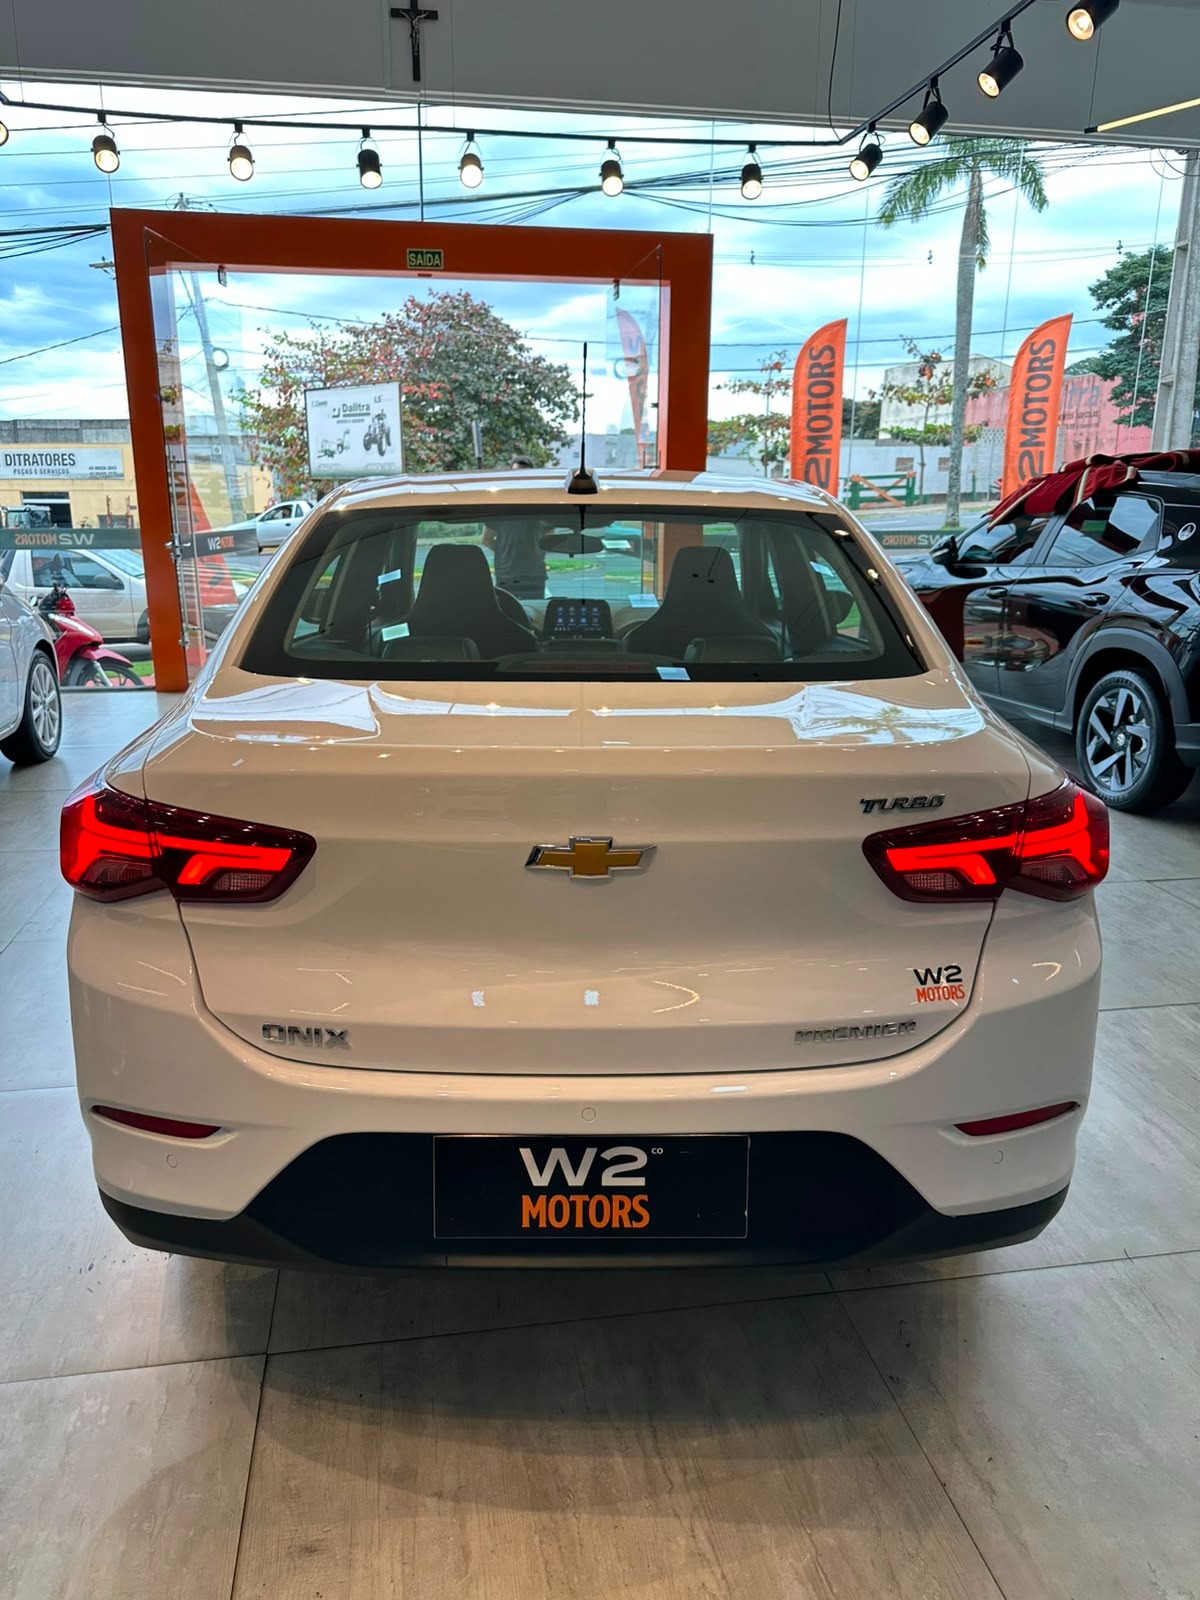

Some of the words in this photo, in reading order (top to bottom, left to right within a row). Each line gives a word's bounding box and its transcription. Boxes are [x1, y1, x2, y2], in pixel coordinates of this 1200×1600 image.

[409, 250, 441, 266] SAÍDA
[4, 453, 76, 467] DITRATORES
[13, 468, 33, 476] PEÇAS
[39, 468, 70, 476] SERVIÇOS
[860, 793, 946, 813] TURBO
[913, 965, 963, 986] W2
[915, 984, 966, 1004] MOTORS
[262, 1023, 351, 1048] ONIX
[794, 1019, 917, 1045] PREMIER
[519, 1146, 648, 1187] W2
[521, 1194, 650, 1228] MOTORS
